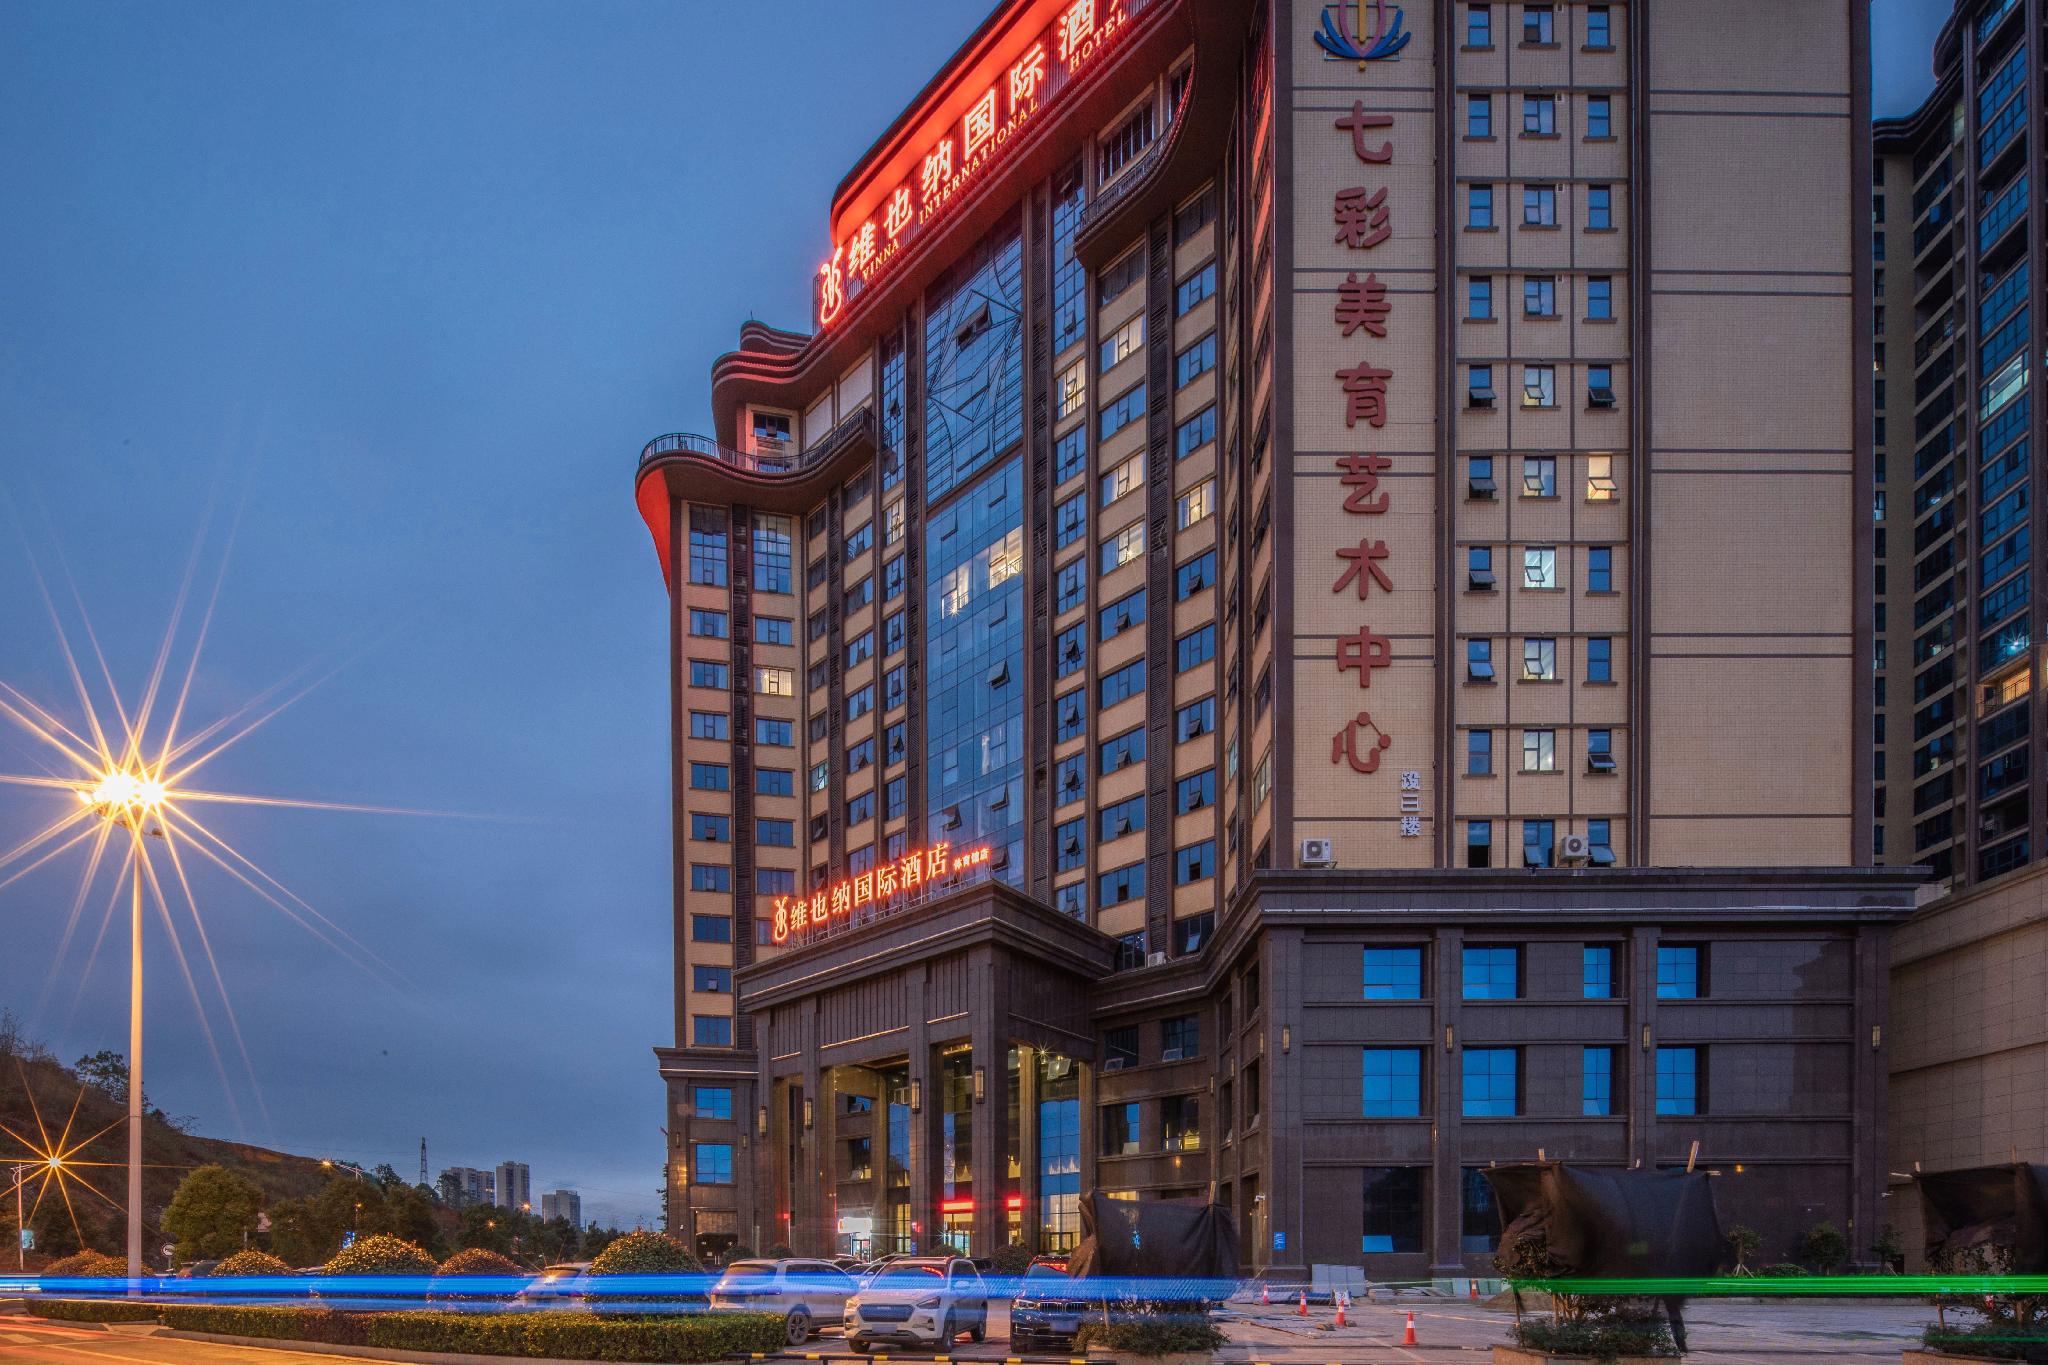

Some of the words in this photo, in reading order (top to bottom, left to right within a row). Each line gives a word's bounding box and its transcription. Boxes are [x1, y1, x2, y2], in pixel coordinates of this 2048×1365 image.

[919, 97, 1039, 225] INTERNATIONAL
[1069, 9, 1127, 74] HOTEL
[1332, 100, 1394, 773] 七彩美育艺术中心
[790, 843, 949, 931] 维也纳国际酒店
